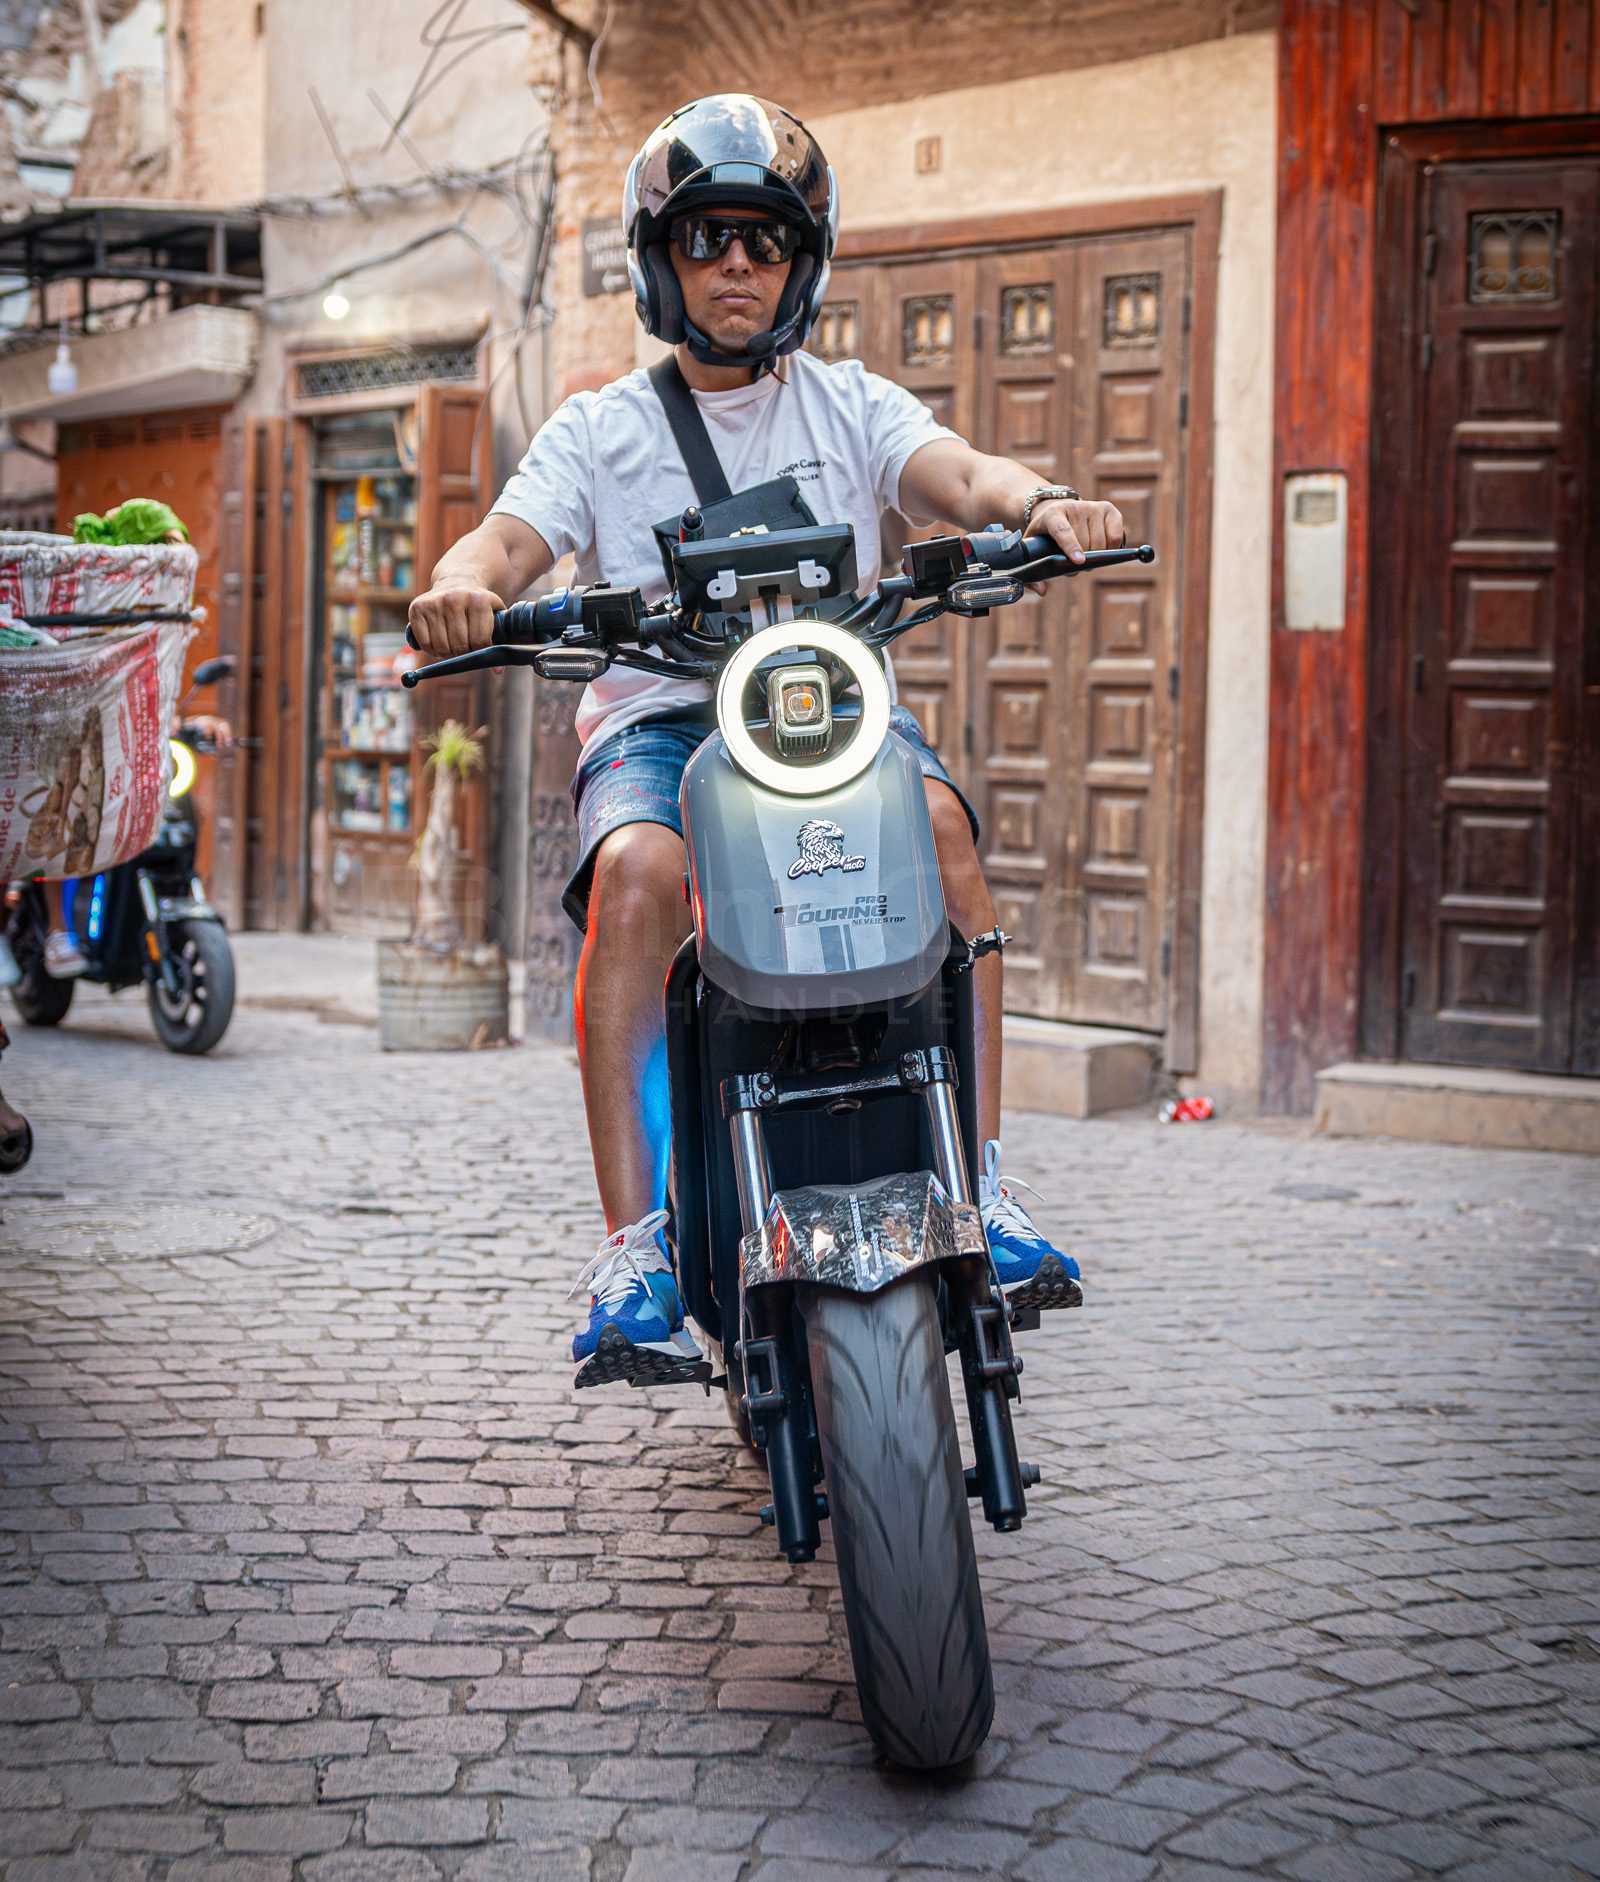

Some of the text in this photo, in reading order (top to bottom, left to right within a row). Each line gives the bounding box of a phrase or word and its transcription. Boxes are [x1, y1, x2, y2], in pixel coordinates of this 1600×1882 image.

[787, 854, 866, 880] Cooper
[842, 860, 866, 872] moto
[855, 895, 888, 905] PRO
[883, 916, 906, 924] STOP
